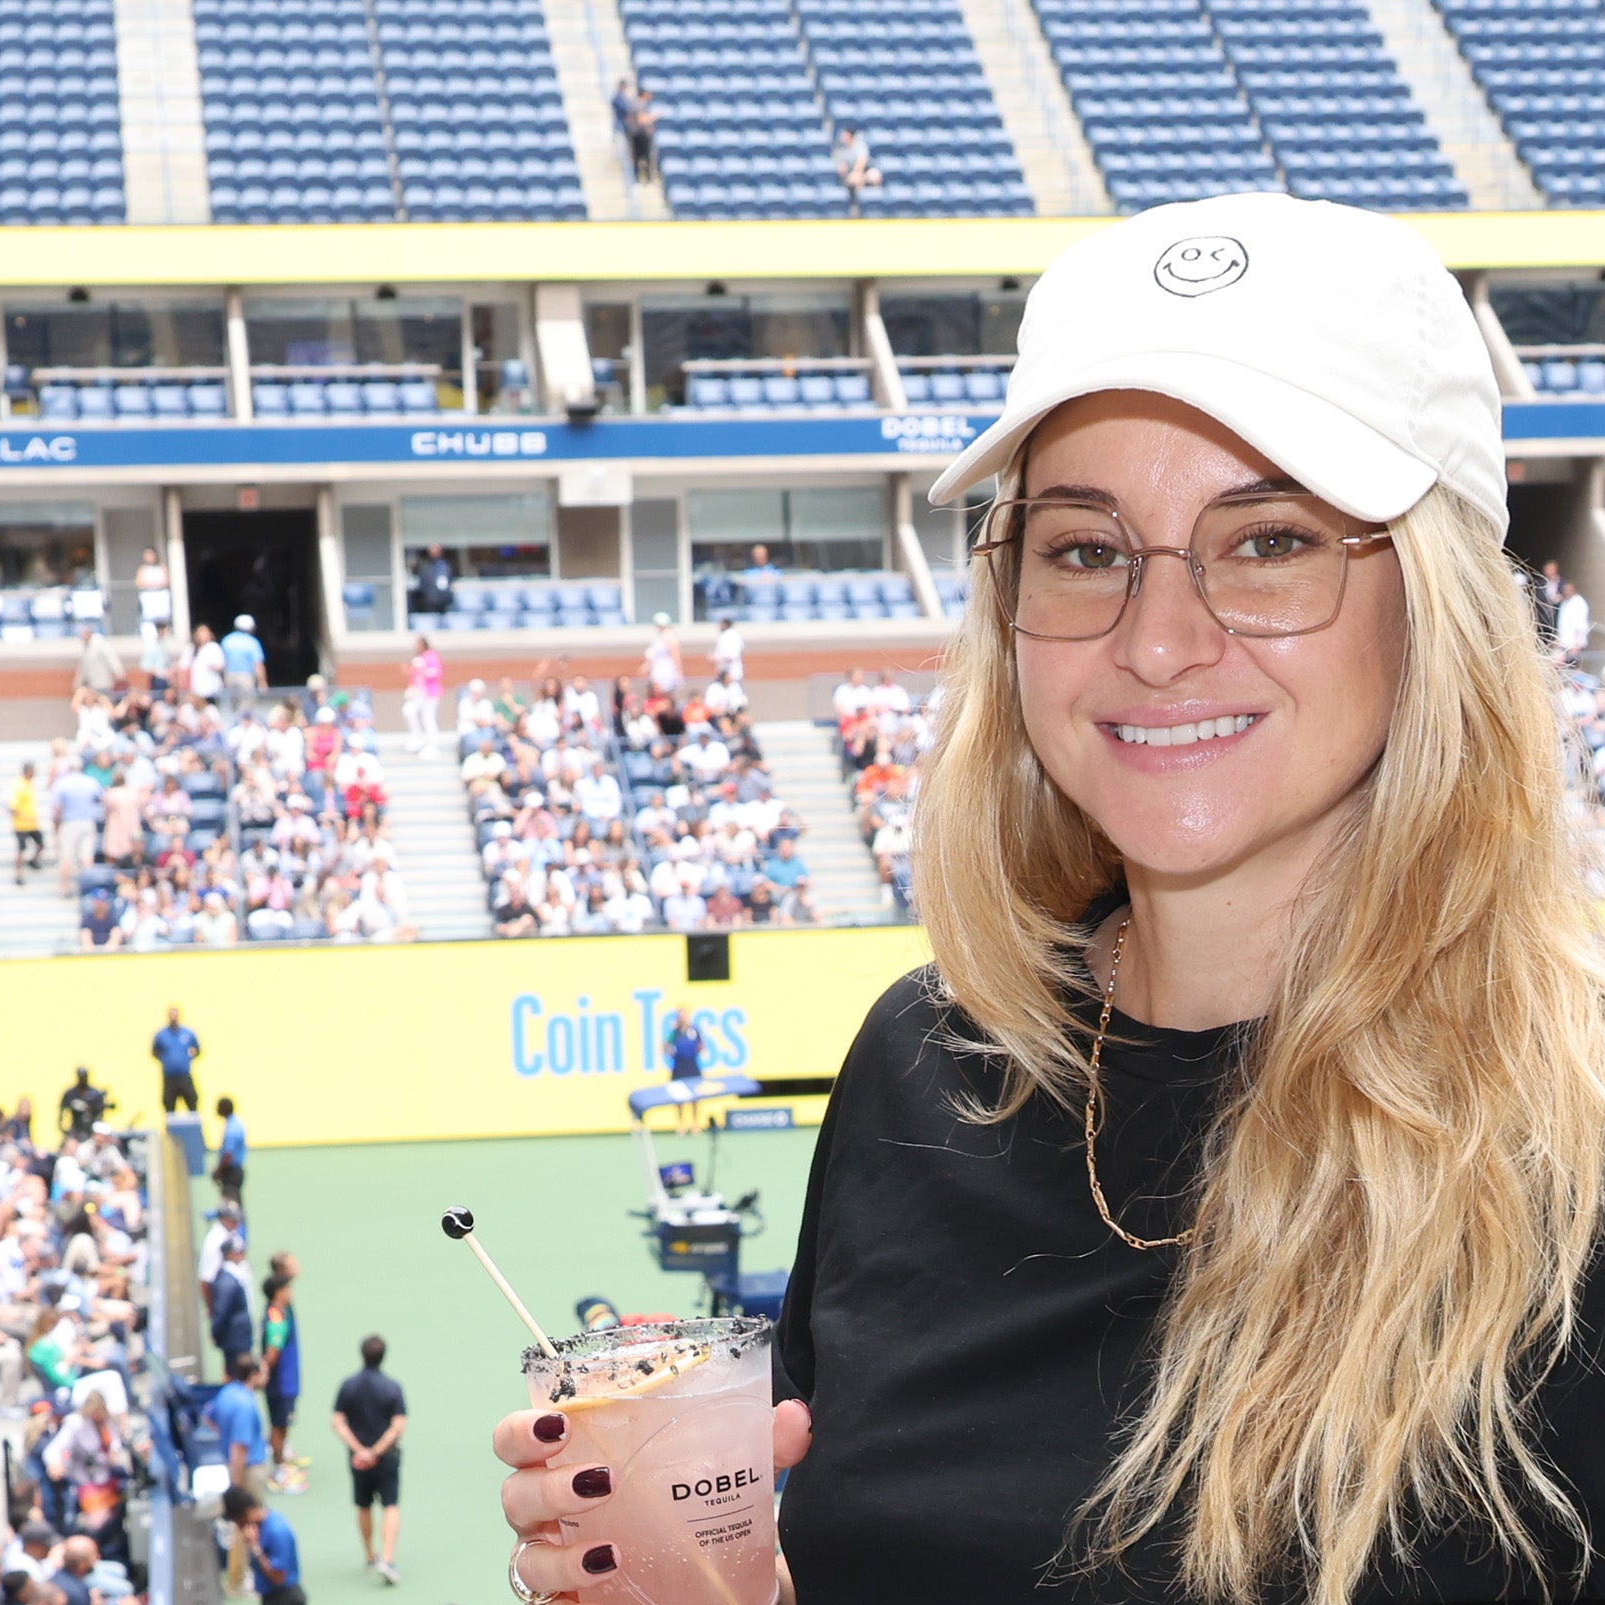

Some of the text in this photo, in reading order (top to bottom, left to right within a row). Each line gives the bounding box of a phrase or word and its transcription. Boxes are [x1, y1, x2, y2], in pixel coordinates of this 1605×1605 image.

[881, 416, 976, 439] DOBEL
[411, 432, 546, 455] CHUBB
[511, 995, 622, 1076] Coin
[672, 1467, 760, 1501] DOBEL
[705, 1493, 741, 1506] TEQUILA
[695, 1518, 753, 1538] OFFICIAL TEQUILA
[699, 1529, 751, 1547] OF THE US OPEN
